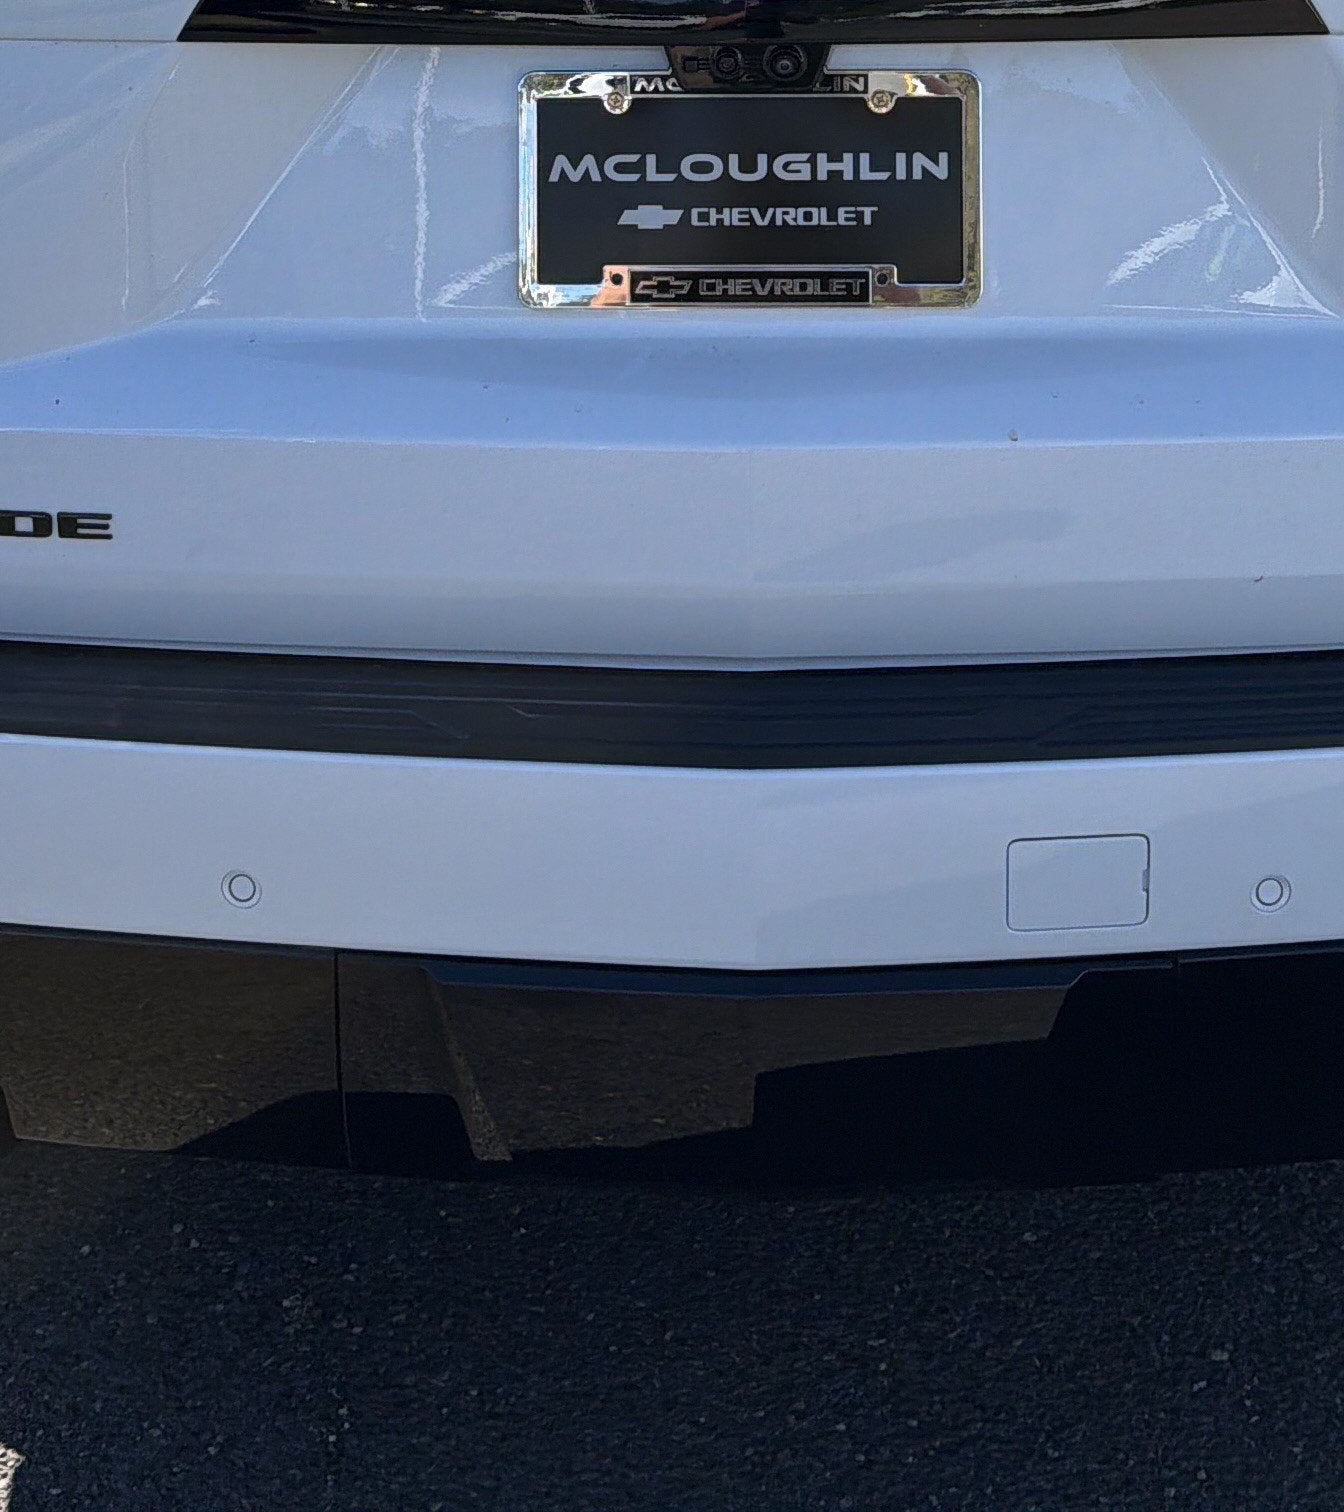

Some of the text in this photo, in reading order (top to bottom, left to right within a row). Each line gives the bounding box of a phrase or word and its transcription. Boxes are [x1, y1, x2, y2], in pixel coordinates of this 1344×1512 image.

[548, 152, 949, 183] MCLOUGHLIN
[691, 206, 878, 227] CHEVROLET
[698, 278, 865, 296] CHEVROLET
